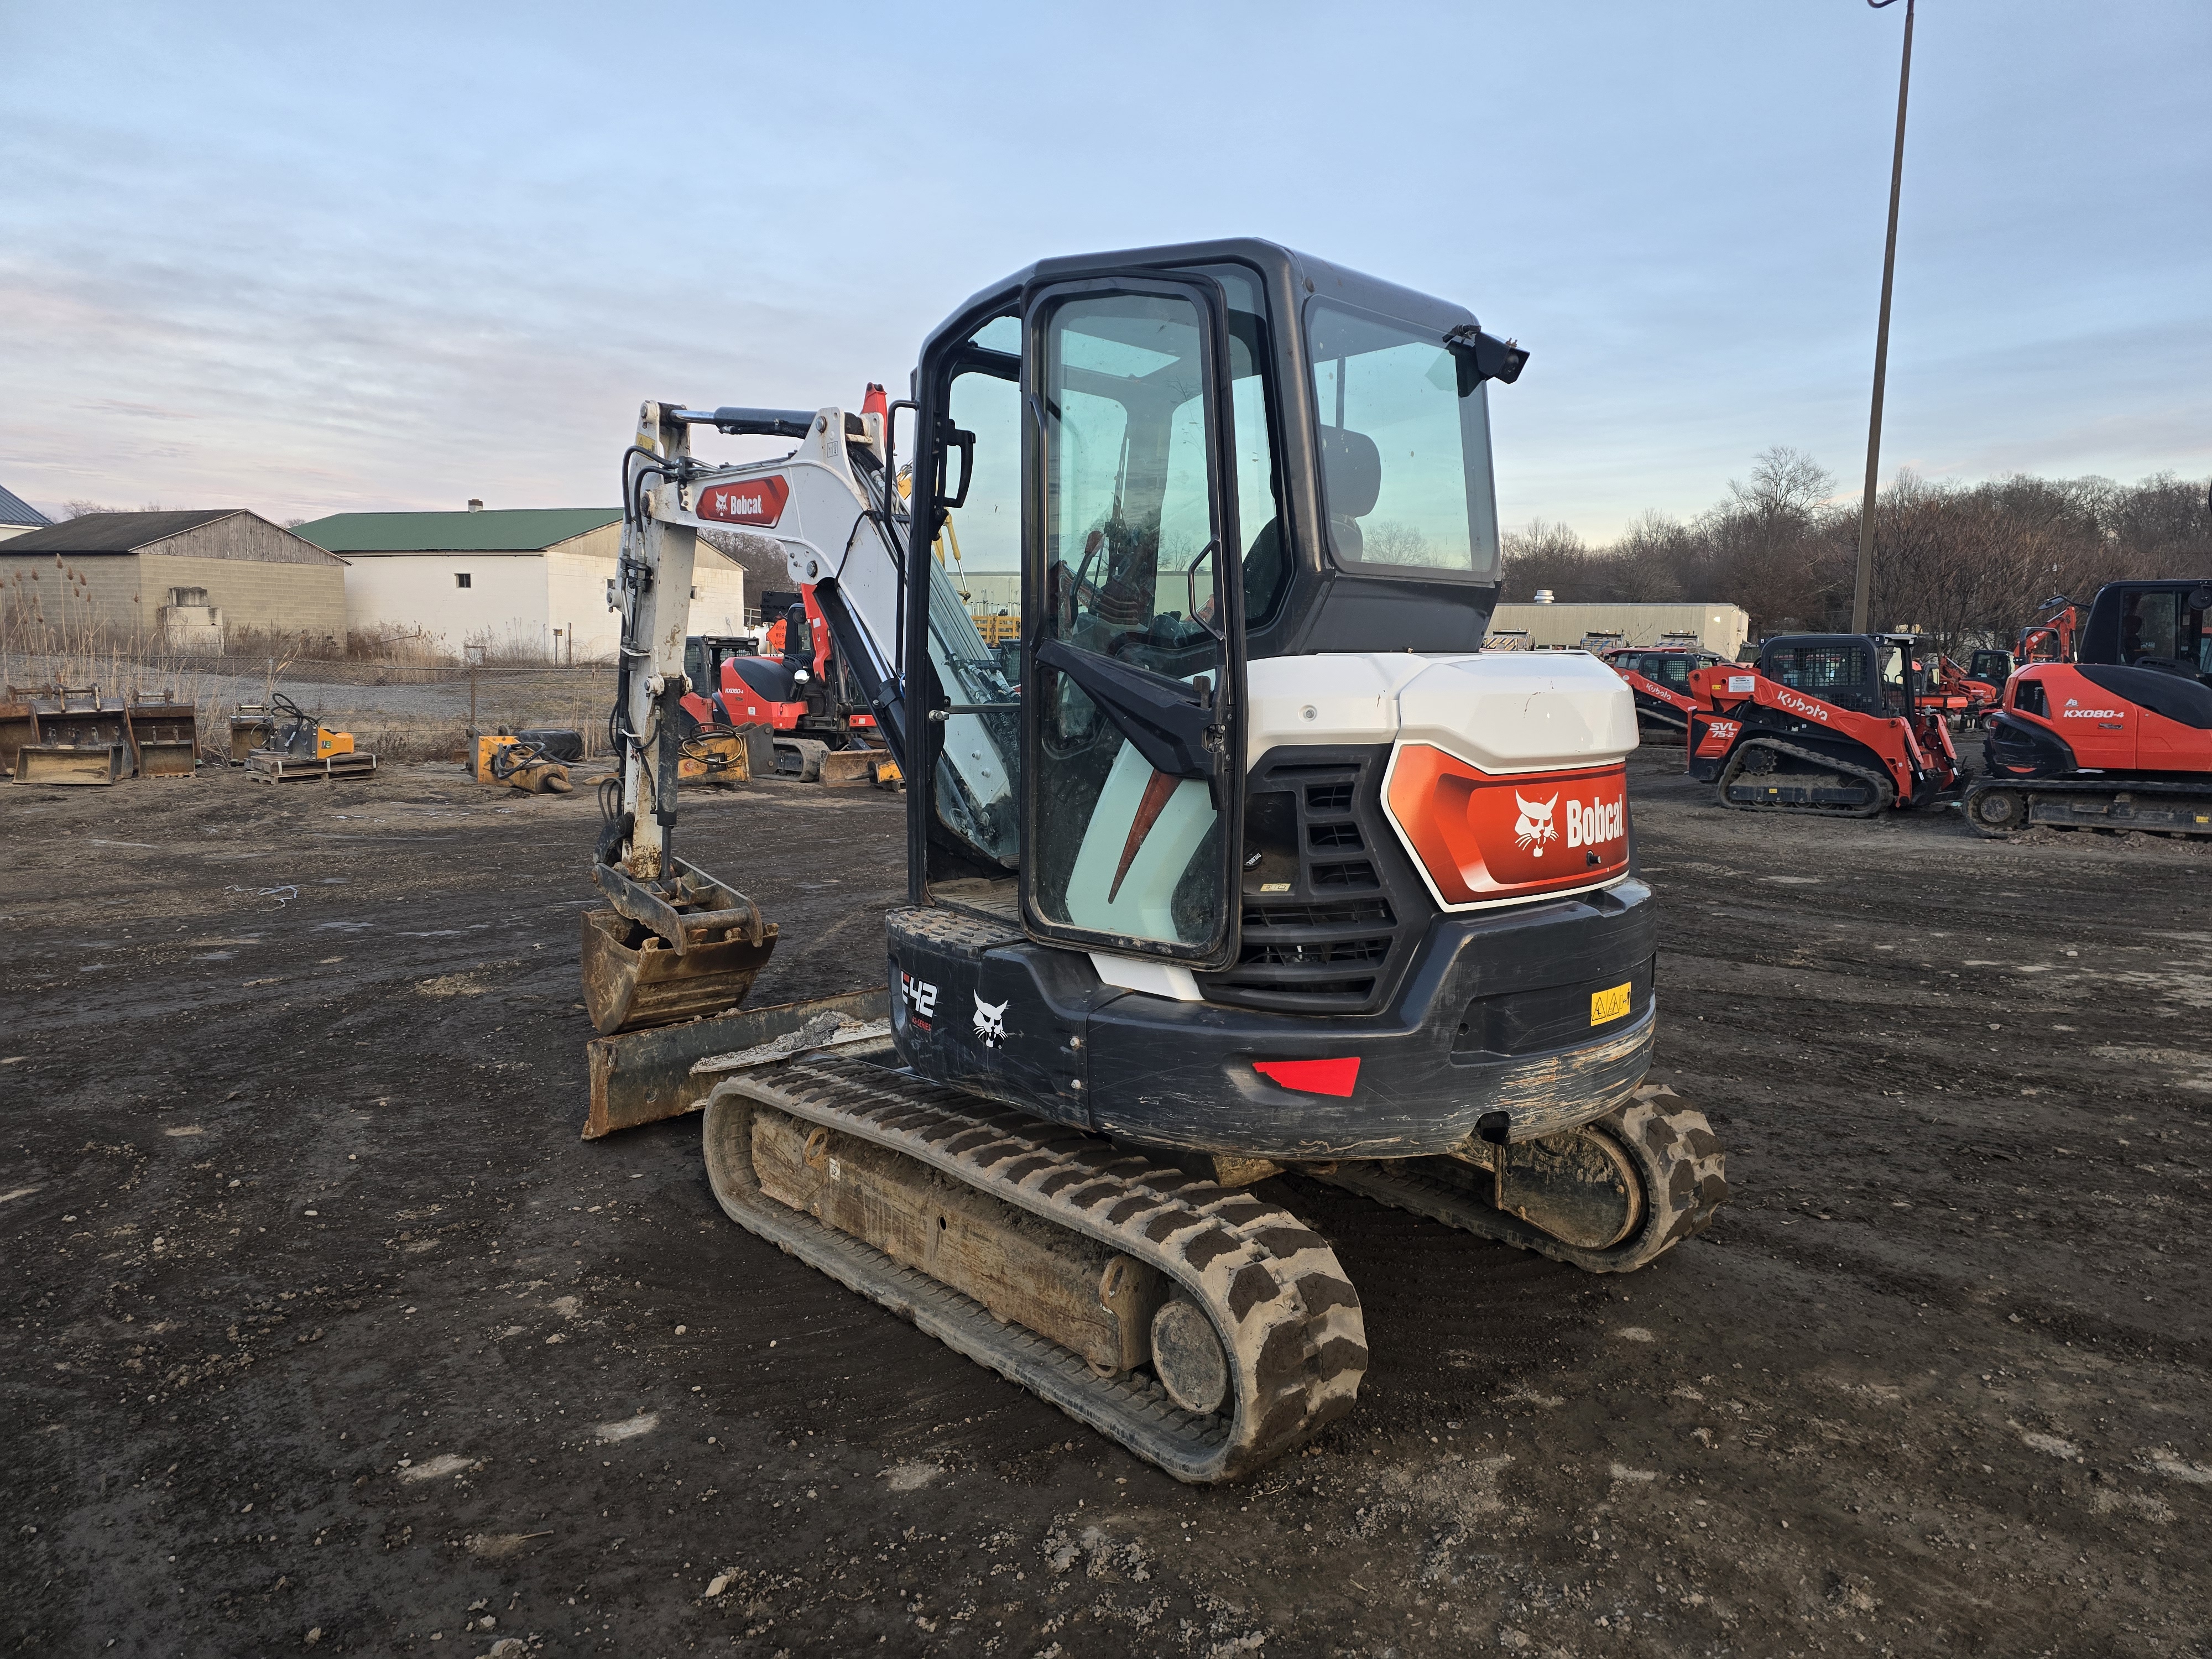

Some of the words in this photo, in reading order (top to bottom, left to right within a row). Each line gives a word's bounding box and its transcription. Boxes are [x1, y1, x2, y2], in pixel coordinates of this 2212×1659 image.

[731, 495, 761, 515] Bobcat
[1646, 682, 1672, 701] Kubota
[1777, 691, 1828, 721] Kubota
[2063, 709, 2125, 718] KX080-4
[1709, 722, 1738, 731] SVL
[1567, 794, 1623, 848] Bobcat
[1246, 853, 1262, 865] DIESEL
[901, 971, 937, 1018] E42
